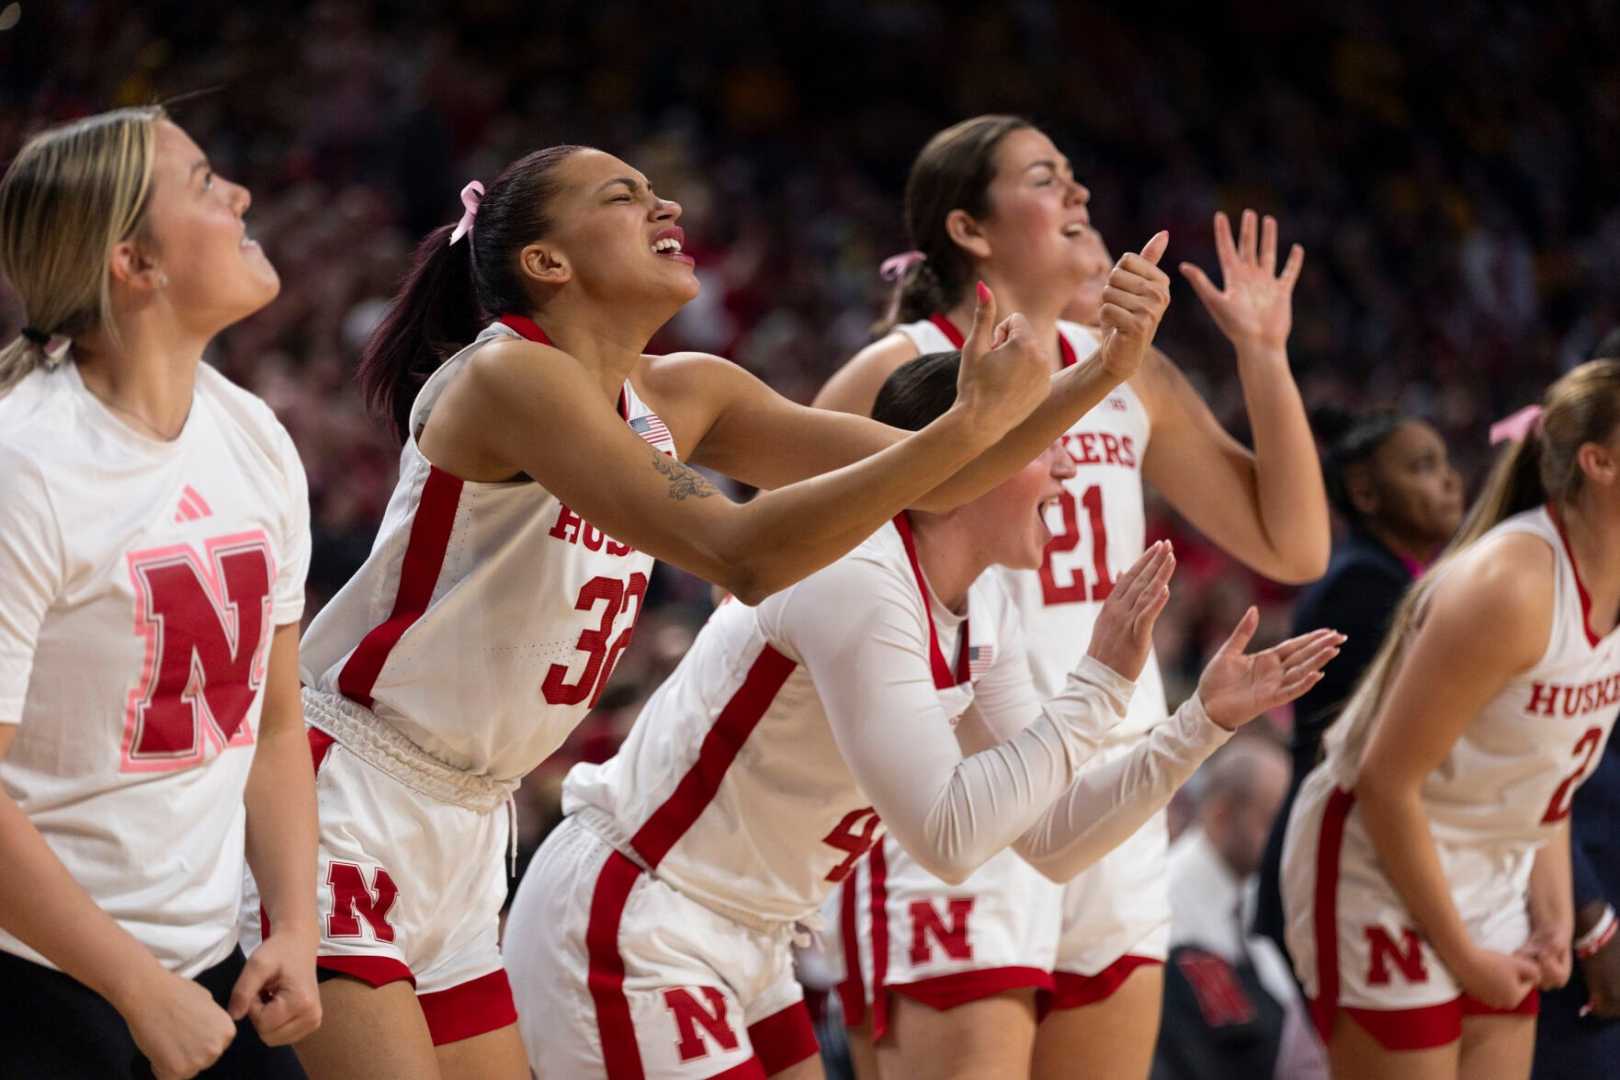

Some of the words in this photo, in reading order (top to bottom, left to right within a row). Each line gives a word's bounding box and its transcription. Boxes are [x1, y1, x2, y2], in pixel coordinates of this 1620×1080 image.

[1038, 485, 1118, 606] 21
[121, 530, 277, 772] N
[1540, 726, 1603, 825] 2
[328, 861, 398, 942] N
[908, 896, 975, 964] N
[1364, 926, 1429, 985] N
[662, 985, 740, 1062] N
